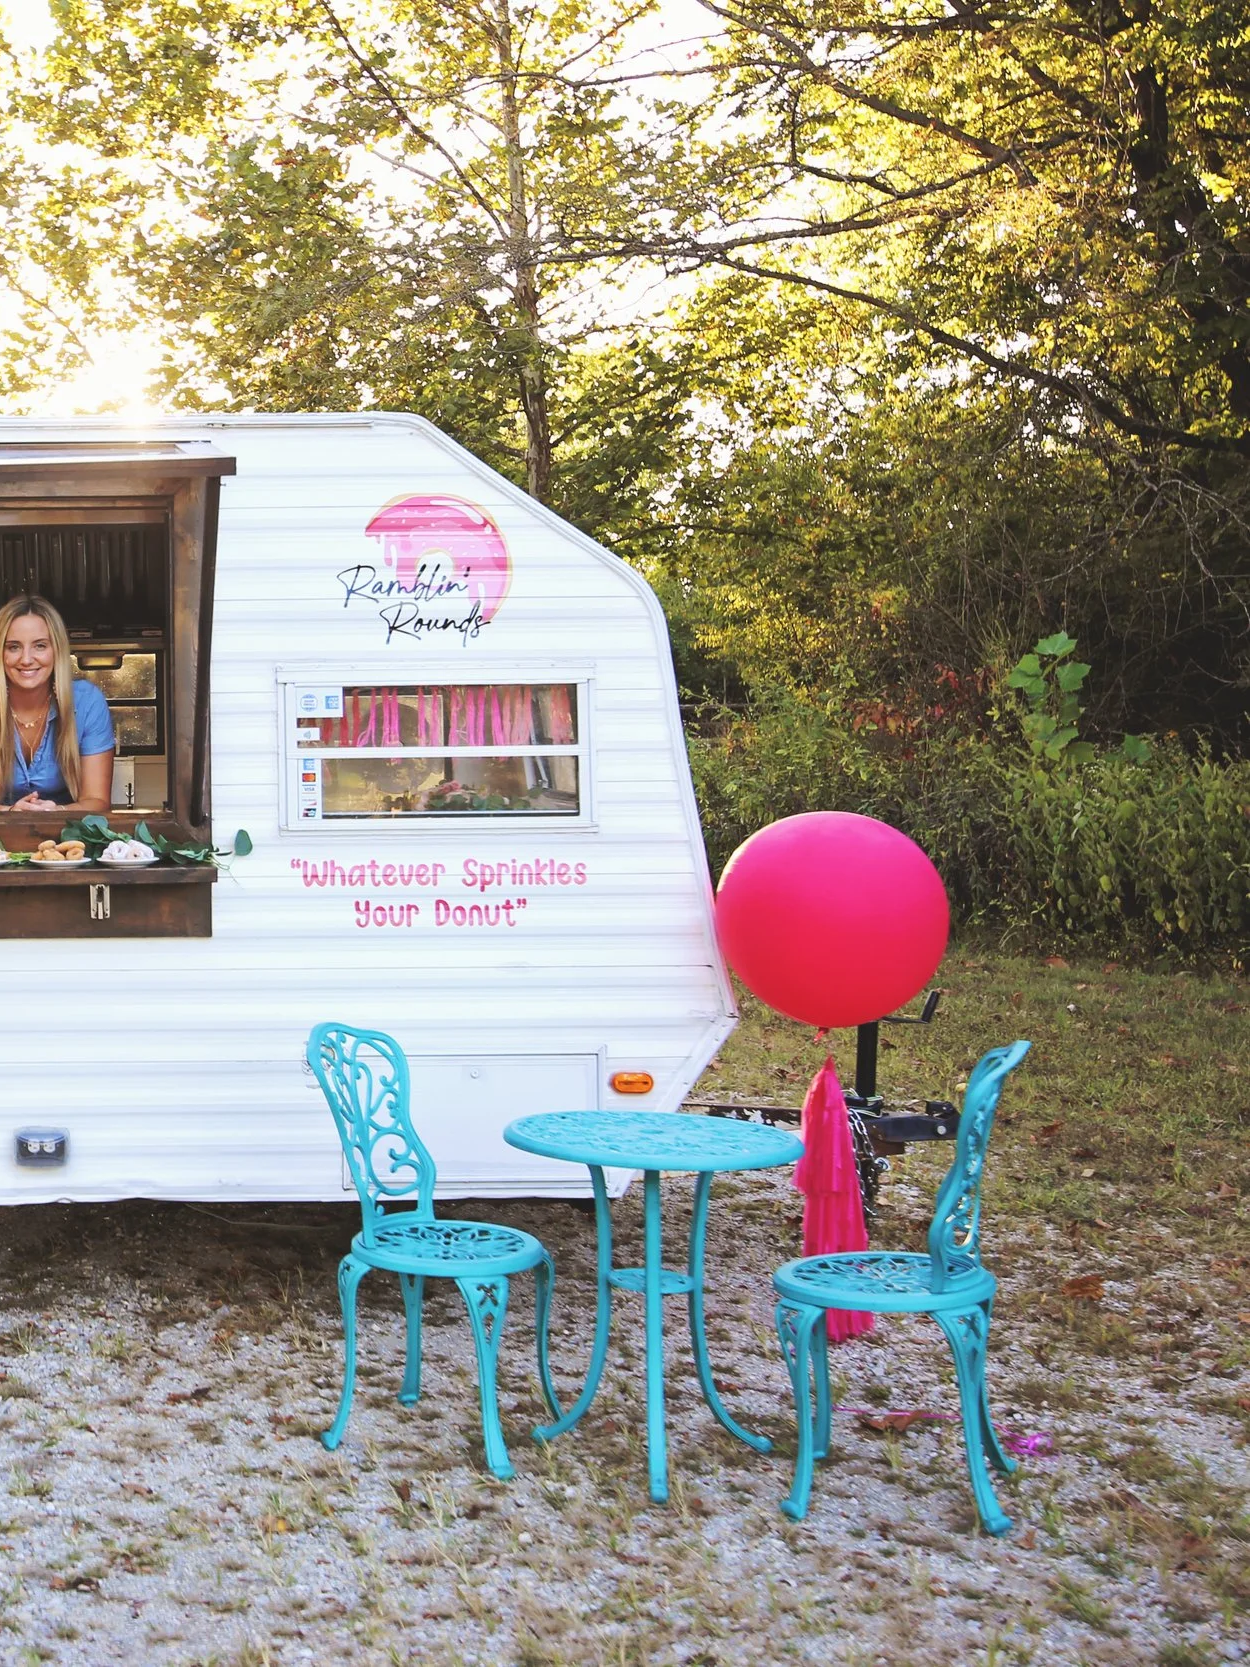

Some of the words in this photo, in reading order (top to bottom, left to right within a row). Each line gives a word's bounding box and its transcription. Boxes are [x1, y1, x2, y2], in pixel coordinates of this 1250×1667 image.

[336, 563, 471, 608] Ramblin'
[379, 600, 491, 648] Rounds
[290, 858, 446, 887] “Whatever
[461, 858, 587, 892] Sprinkles
[354, 900, 420, 928] Your
[435, 898, 527, 927] Donut”
